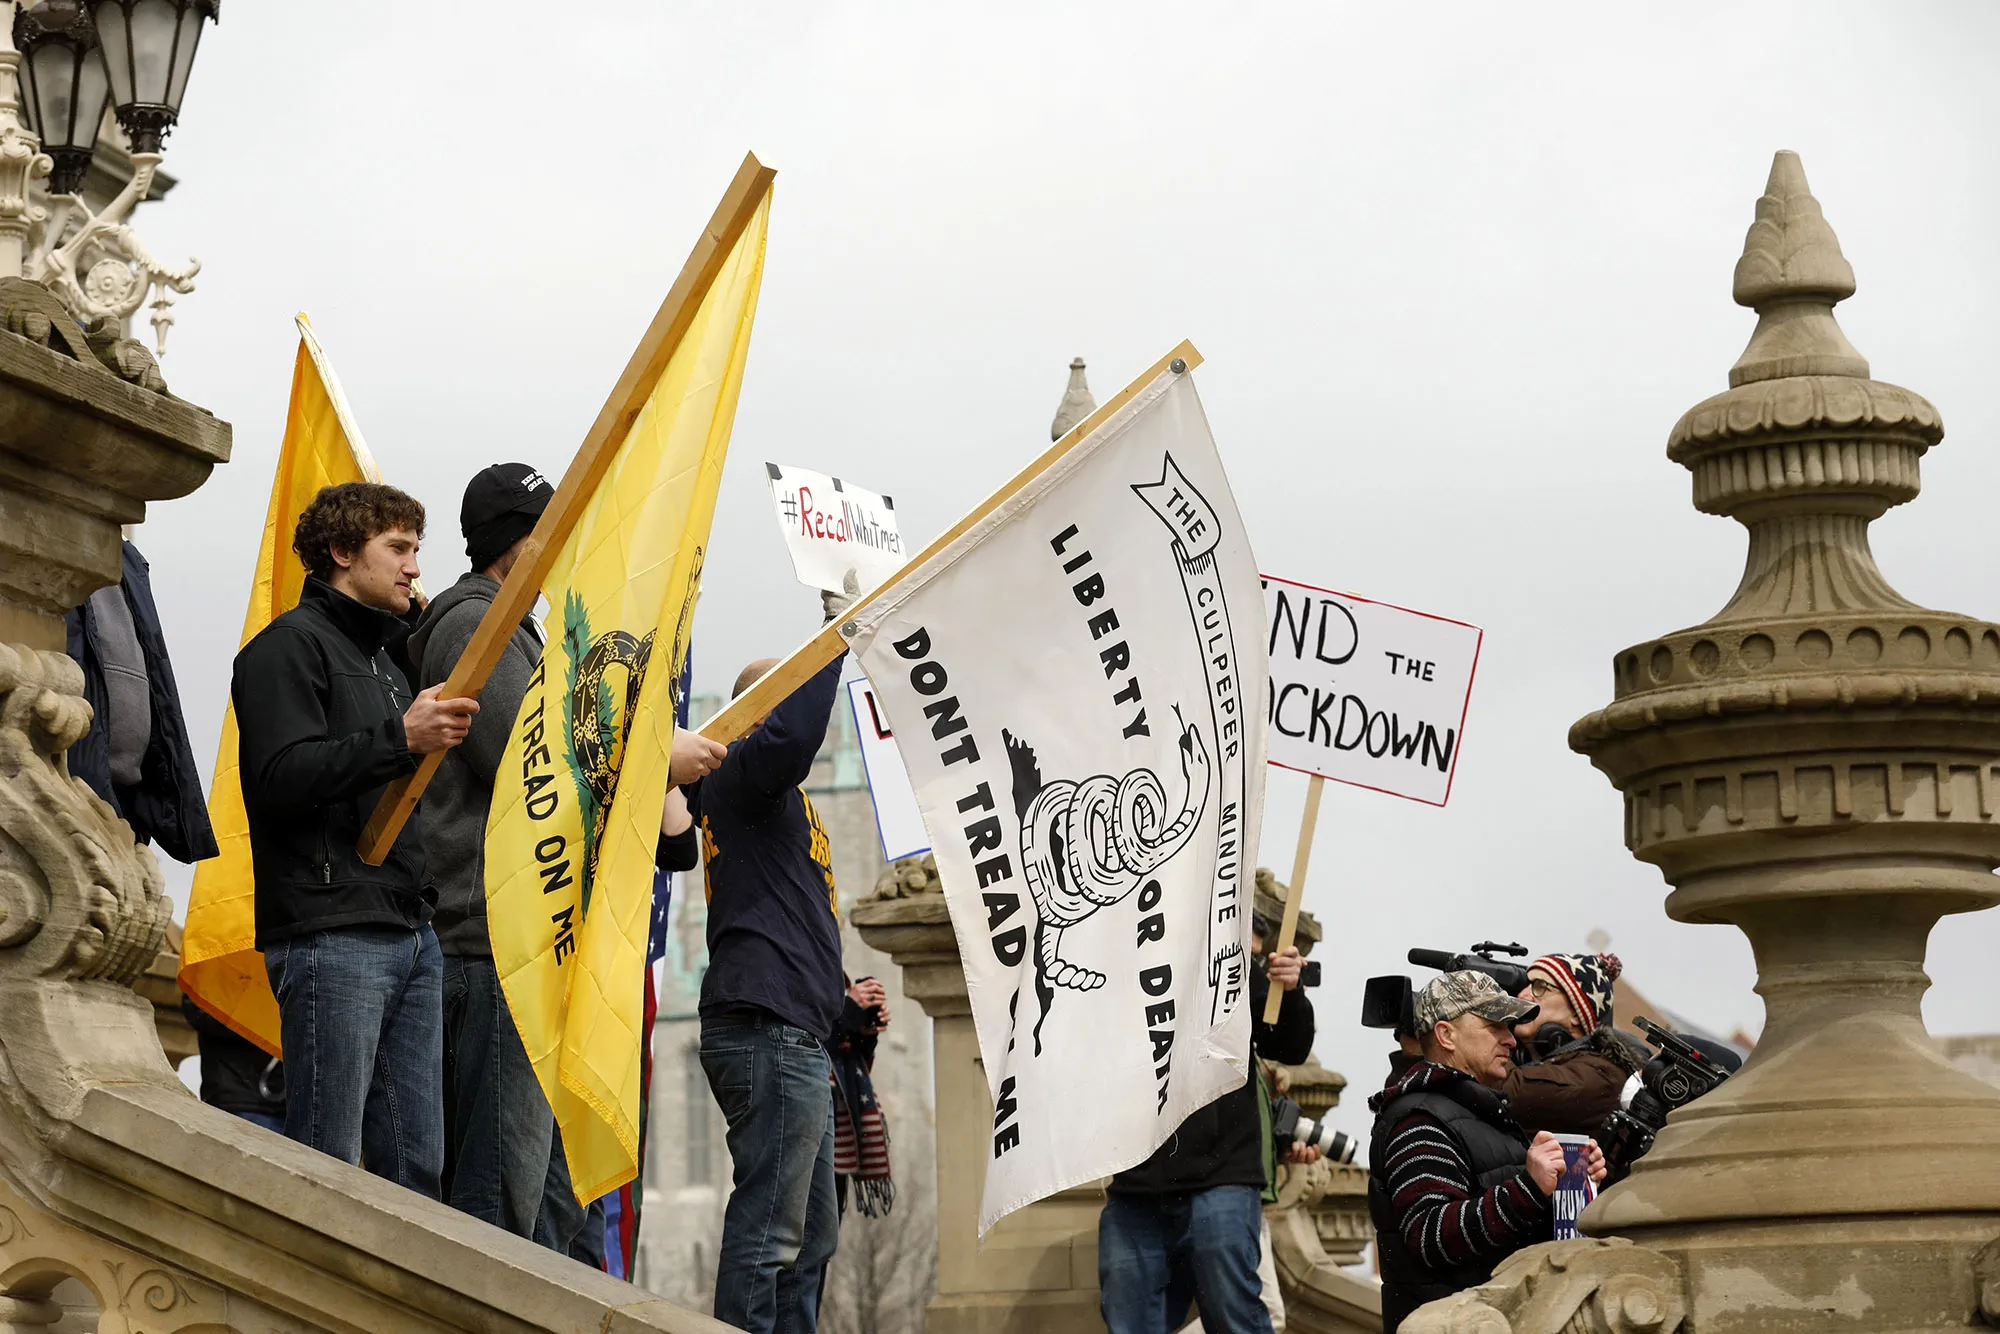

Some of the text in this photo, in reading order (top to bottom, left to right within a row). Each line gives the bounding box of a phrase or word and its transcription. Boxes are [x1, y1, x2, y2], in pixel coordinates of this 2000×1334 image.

[1165, 487, 1207, 543] THE
[1197, 587, 1239, 763] CULPEPER
[1261, 581, 1436, 682] ND THE
[523, 696, 560, 821] TREAD
[1050, 523, 1151, 741] LIBERTY
[1137, 880, 1166, 949] OR
[1269, 675, 1455, 773] CKDOWN
[892, 627, 981, 767] DONT
[956, 781, 1028, 968] TREAD
[534, 834, 574, 896] ON
[1216, 801, 1237, 924] MINUTE
[551, 903, 576, 967] ME
